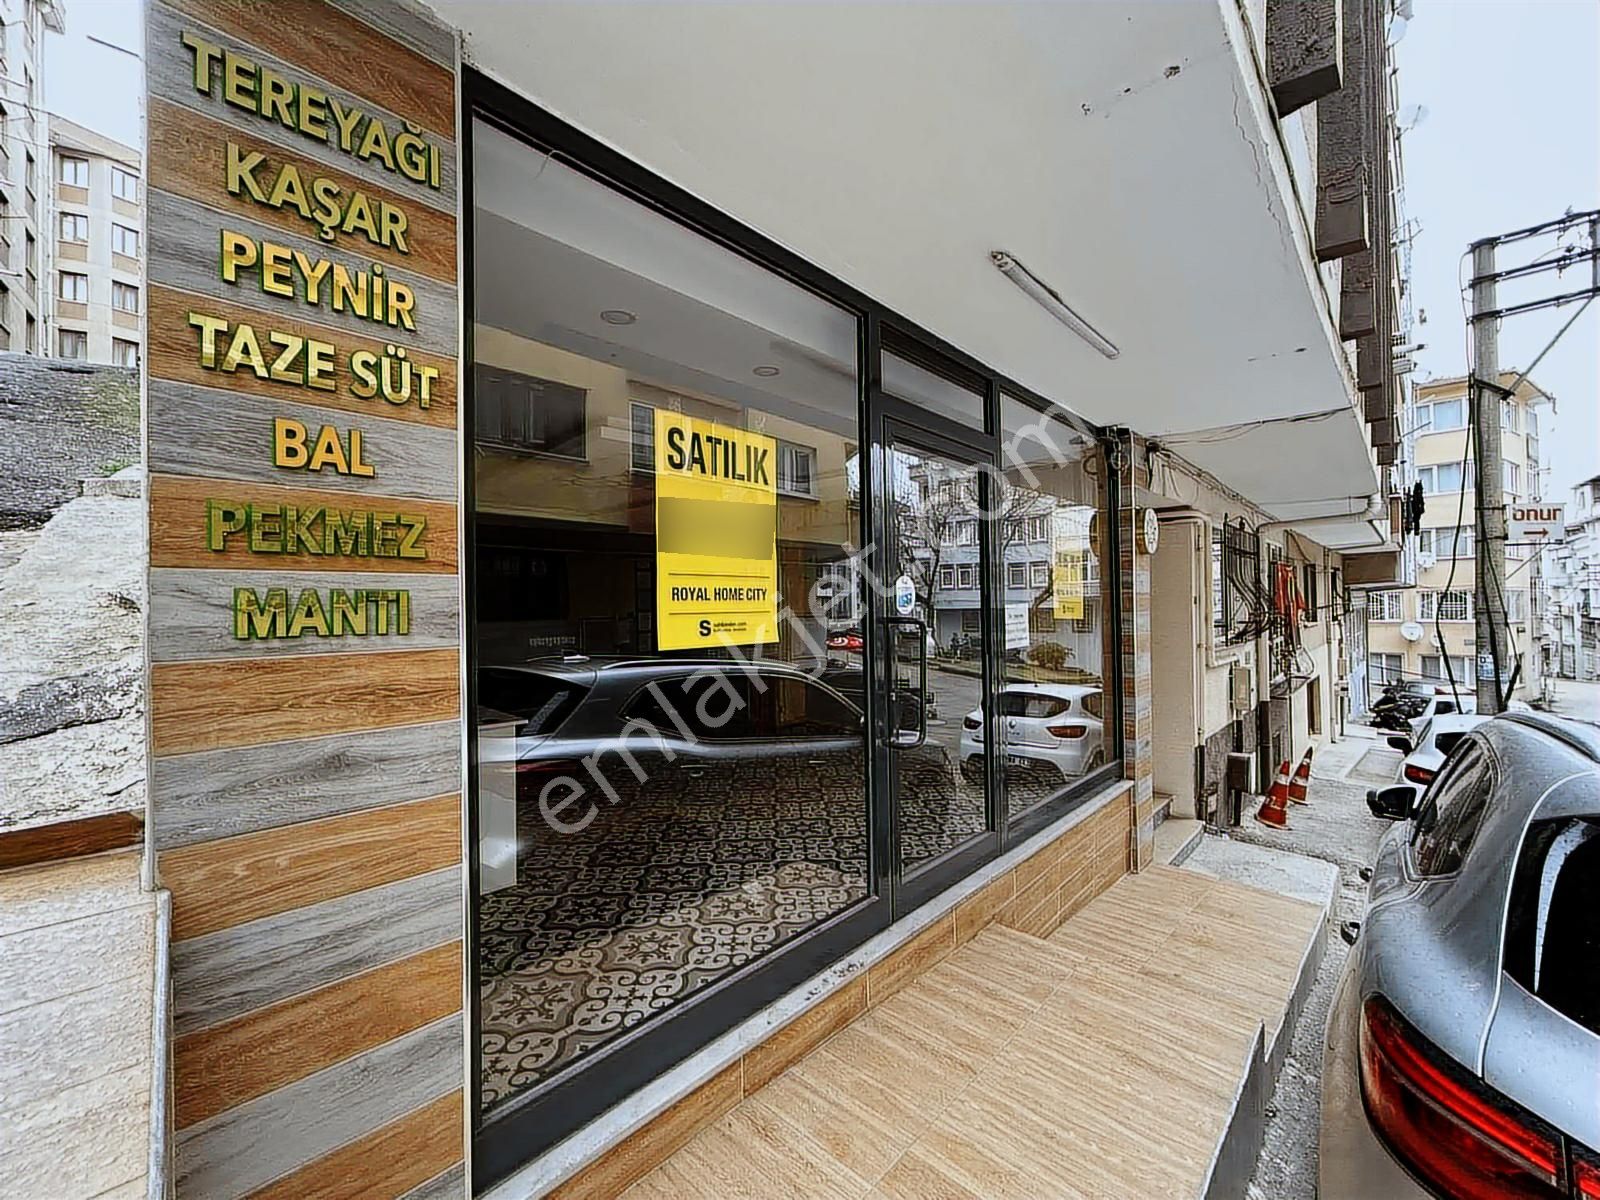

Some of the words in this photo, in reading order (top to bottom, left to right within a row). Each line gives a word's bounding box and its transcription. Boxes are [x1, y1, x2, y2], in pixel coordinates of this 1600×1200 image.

[180, 29, 441, 190] TEREYAĞI
[225, 142, 409, 253] KAŞAR
[220, 229, 416, 331] PEYNİR
[188, 312, 337, 392] TAZE
[349, 344, 440, 409] SÜT
[273, 417, 375, 478] BAL
[667, 426, 769, 486] SATILIK
[206, 498, 427, 559] PEKMEZ
[234, 586, 411, 639] MANTI
[671, 586, 710, 601] ROYAL
[714, 587, 744, 601] HOME
[746, 588, 767, 601] CITY
[699, 619, 712, 637] S
